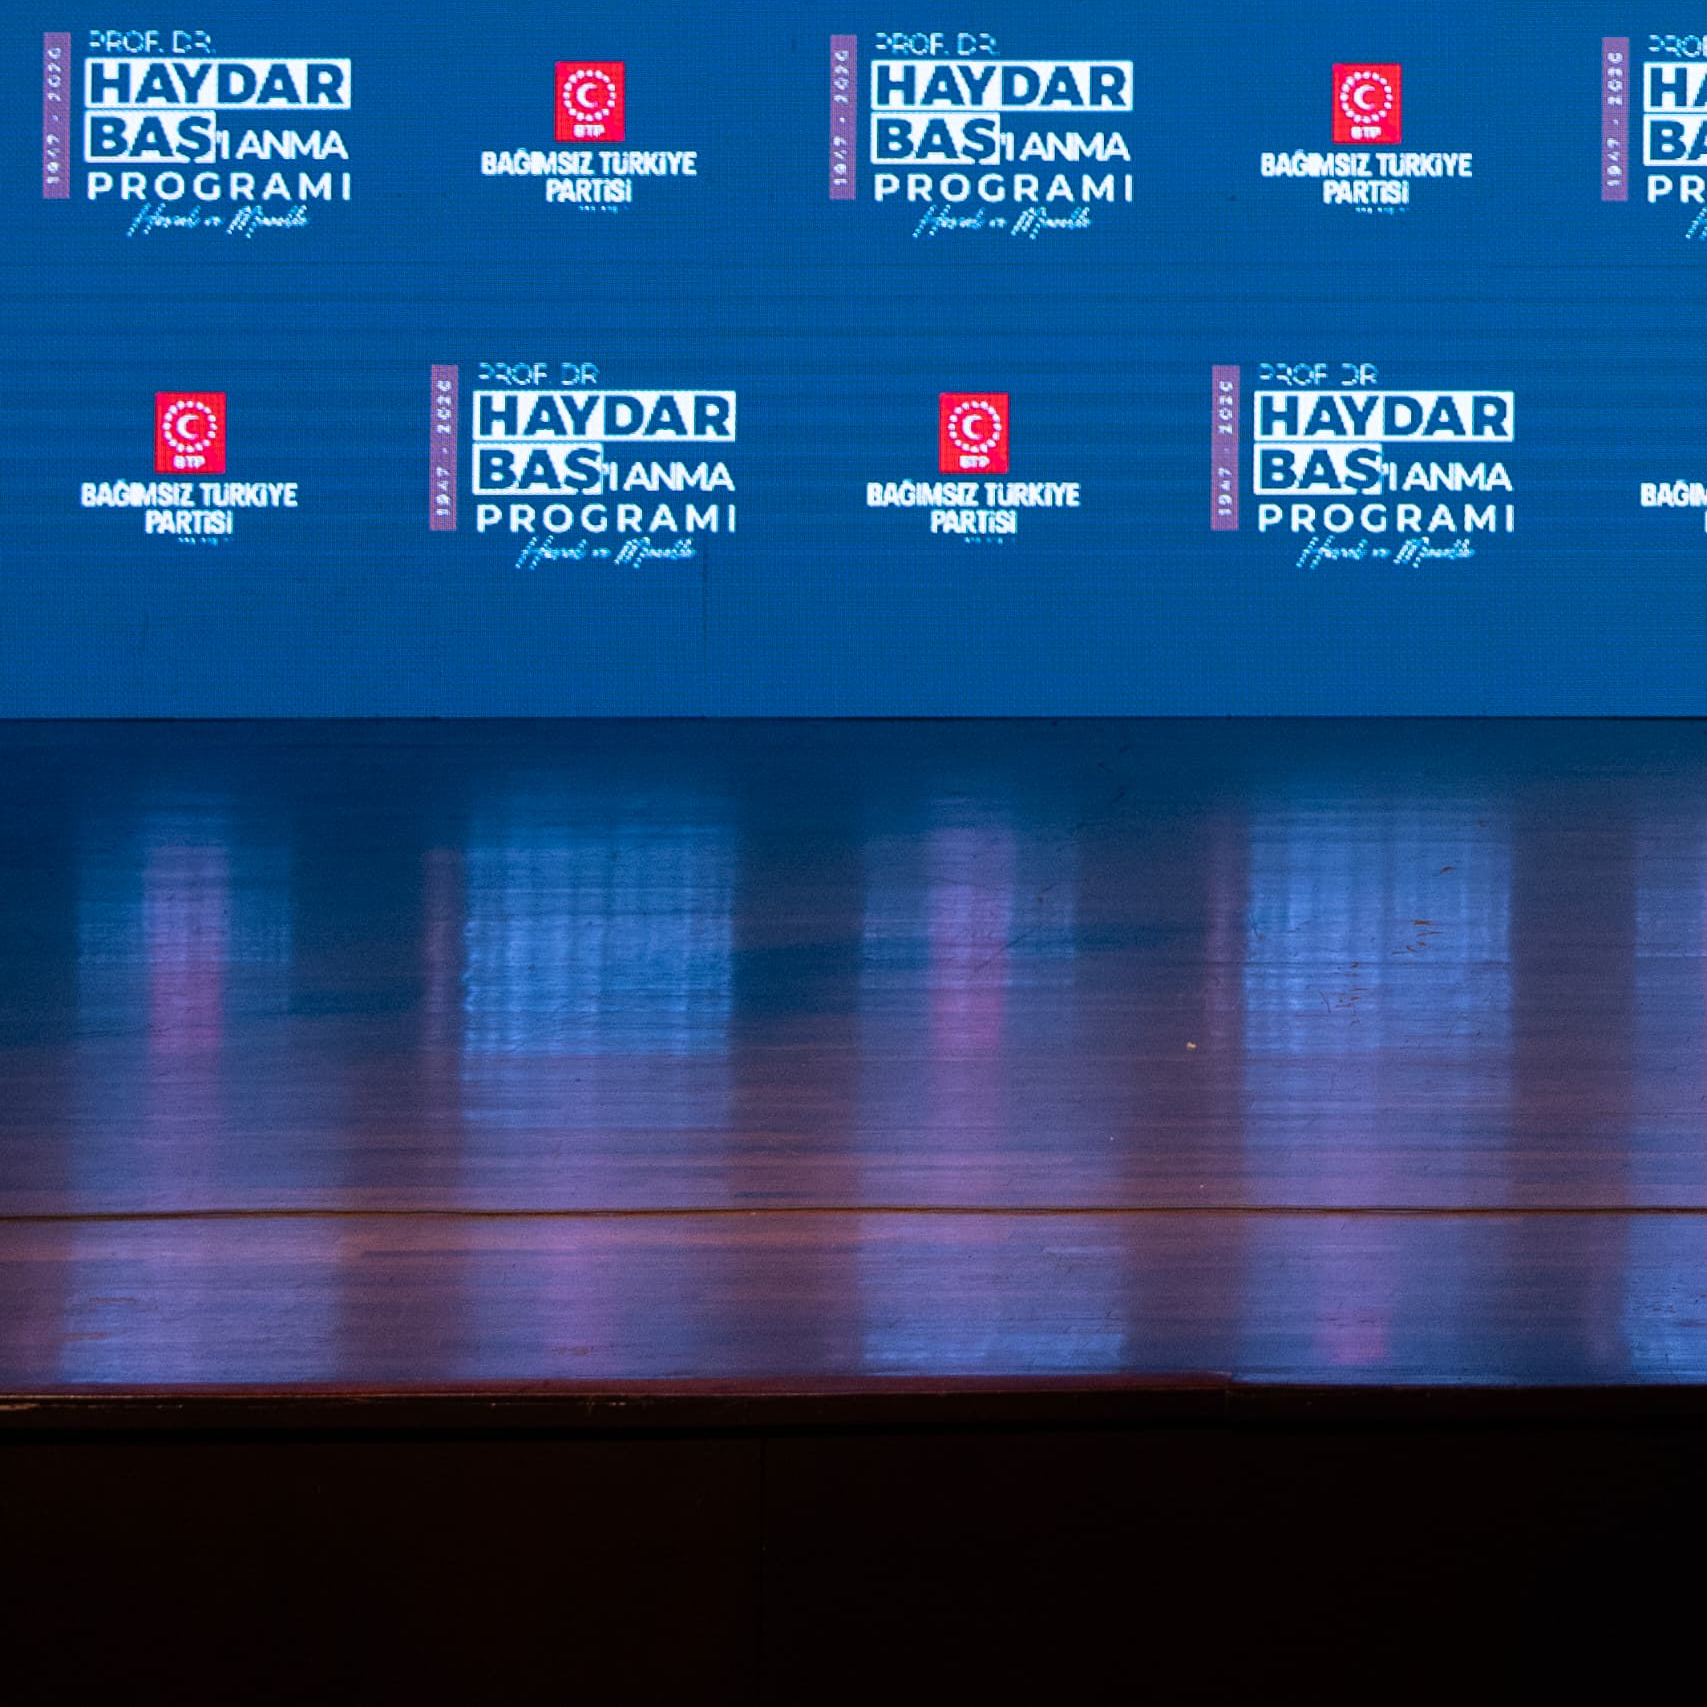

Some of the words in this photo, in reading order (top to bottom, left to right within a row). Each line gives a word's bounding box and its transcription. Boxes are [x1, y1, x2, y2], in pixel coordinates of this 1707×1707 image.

[90, 63, 345, 104] HAYDAR
[877, 65, 1127, 106] HAYDAR
[236, 130, 348, 159] ANMA
[1020, 133, 1130, 161] ANMA
[88, 172, 350, 200] PROGRAMI
[875, 174, 1132, 202] PROGRAMI
[478, 396, 730, 437] HAYDAR
[1259, 396, 1507, 437] HAYDAR
[624, 462, 734, 491] ANMA
[1403, 463, 1512, 491] ANMA
[477, 504, 735, 532] PROGRAMI
[1259, 504, 1513, 532] PROGRAMI
